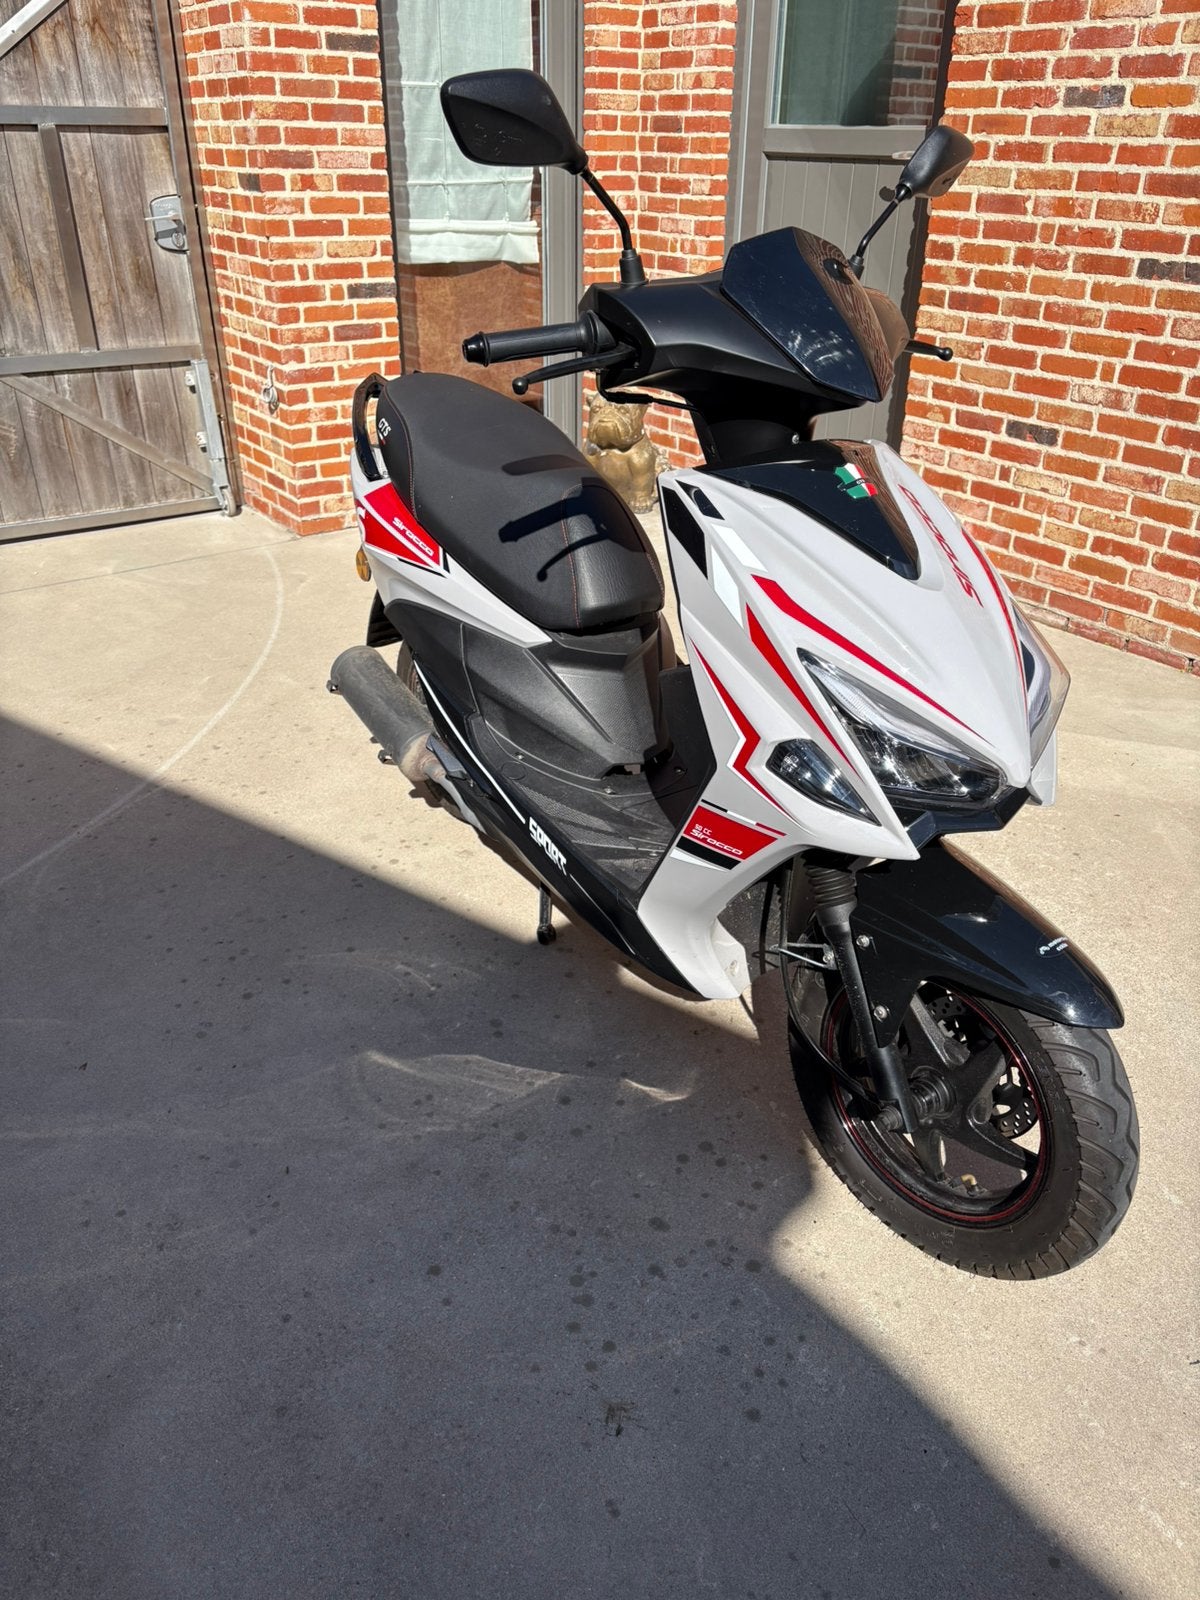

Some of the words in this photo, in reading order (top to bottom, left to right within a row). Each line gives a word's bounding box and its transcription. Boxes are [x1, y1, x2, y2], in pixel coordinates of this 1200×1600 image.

[378, 417, 392, 437] GTS
[392, 516, 435, 558] Sirocco
[529, 816, 567, 876] SPORT
[690, 828, 743, 856] Sirocco
